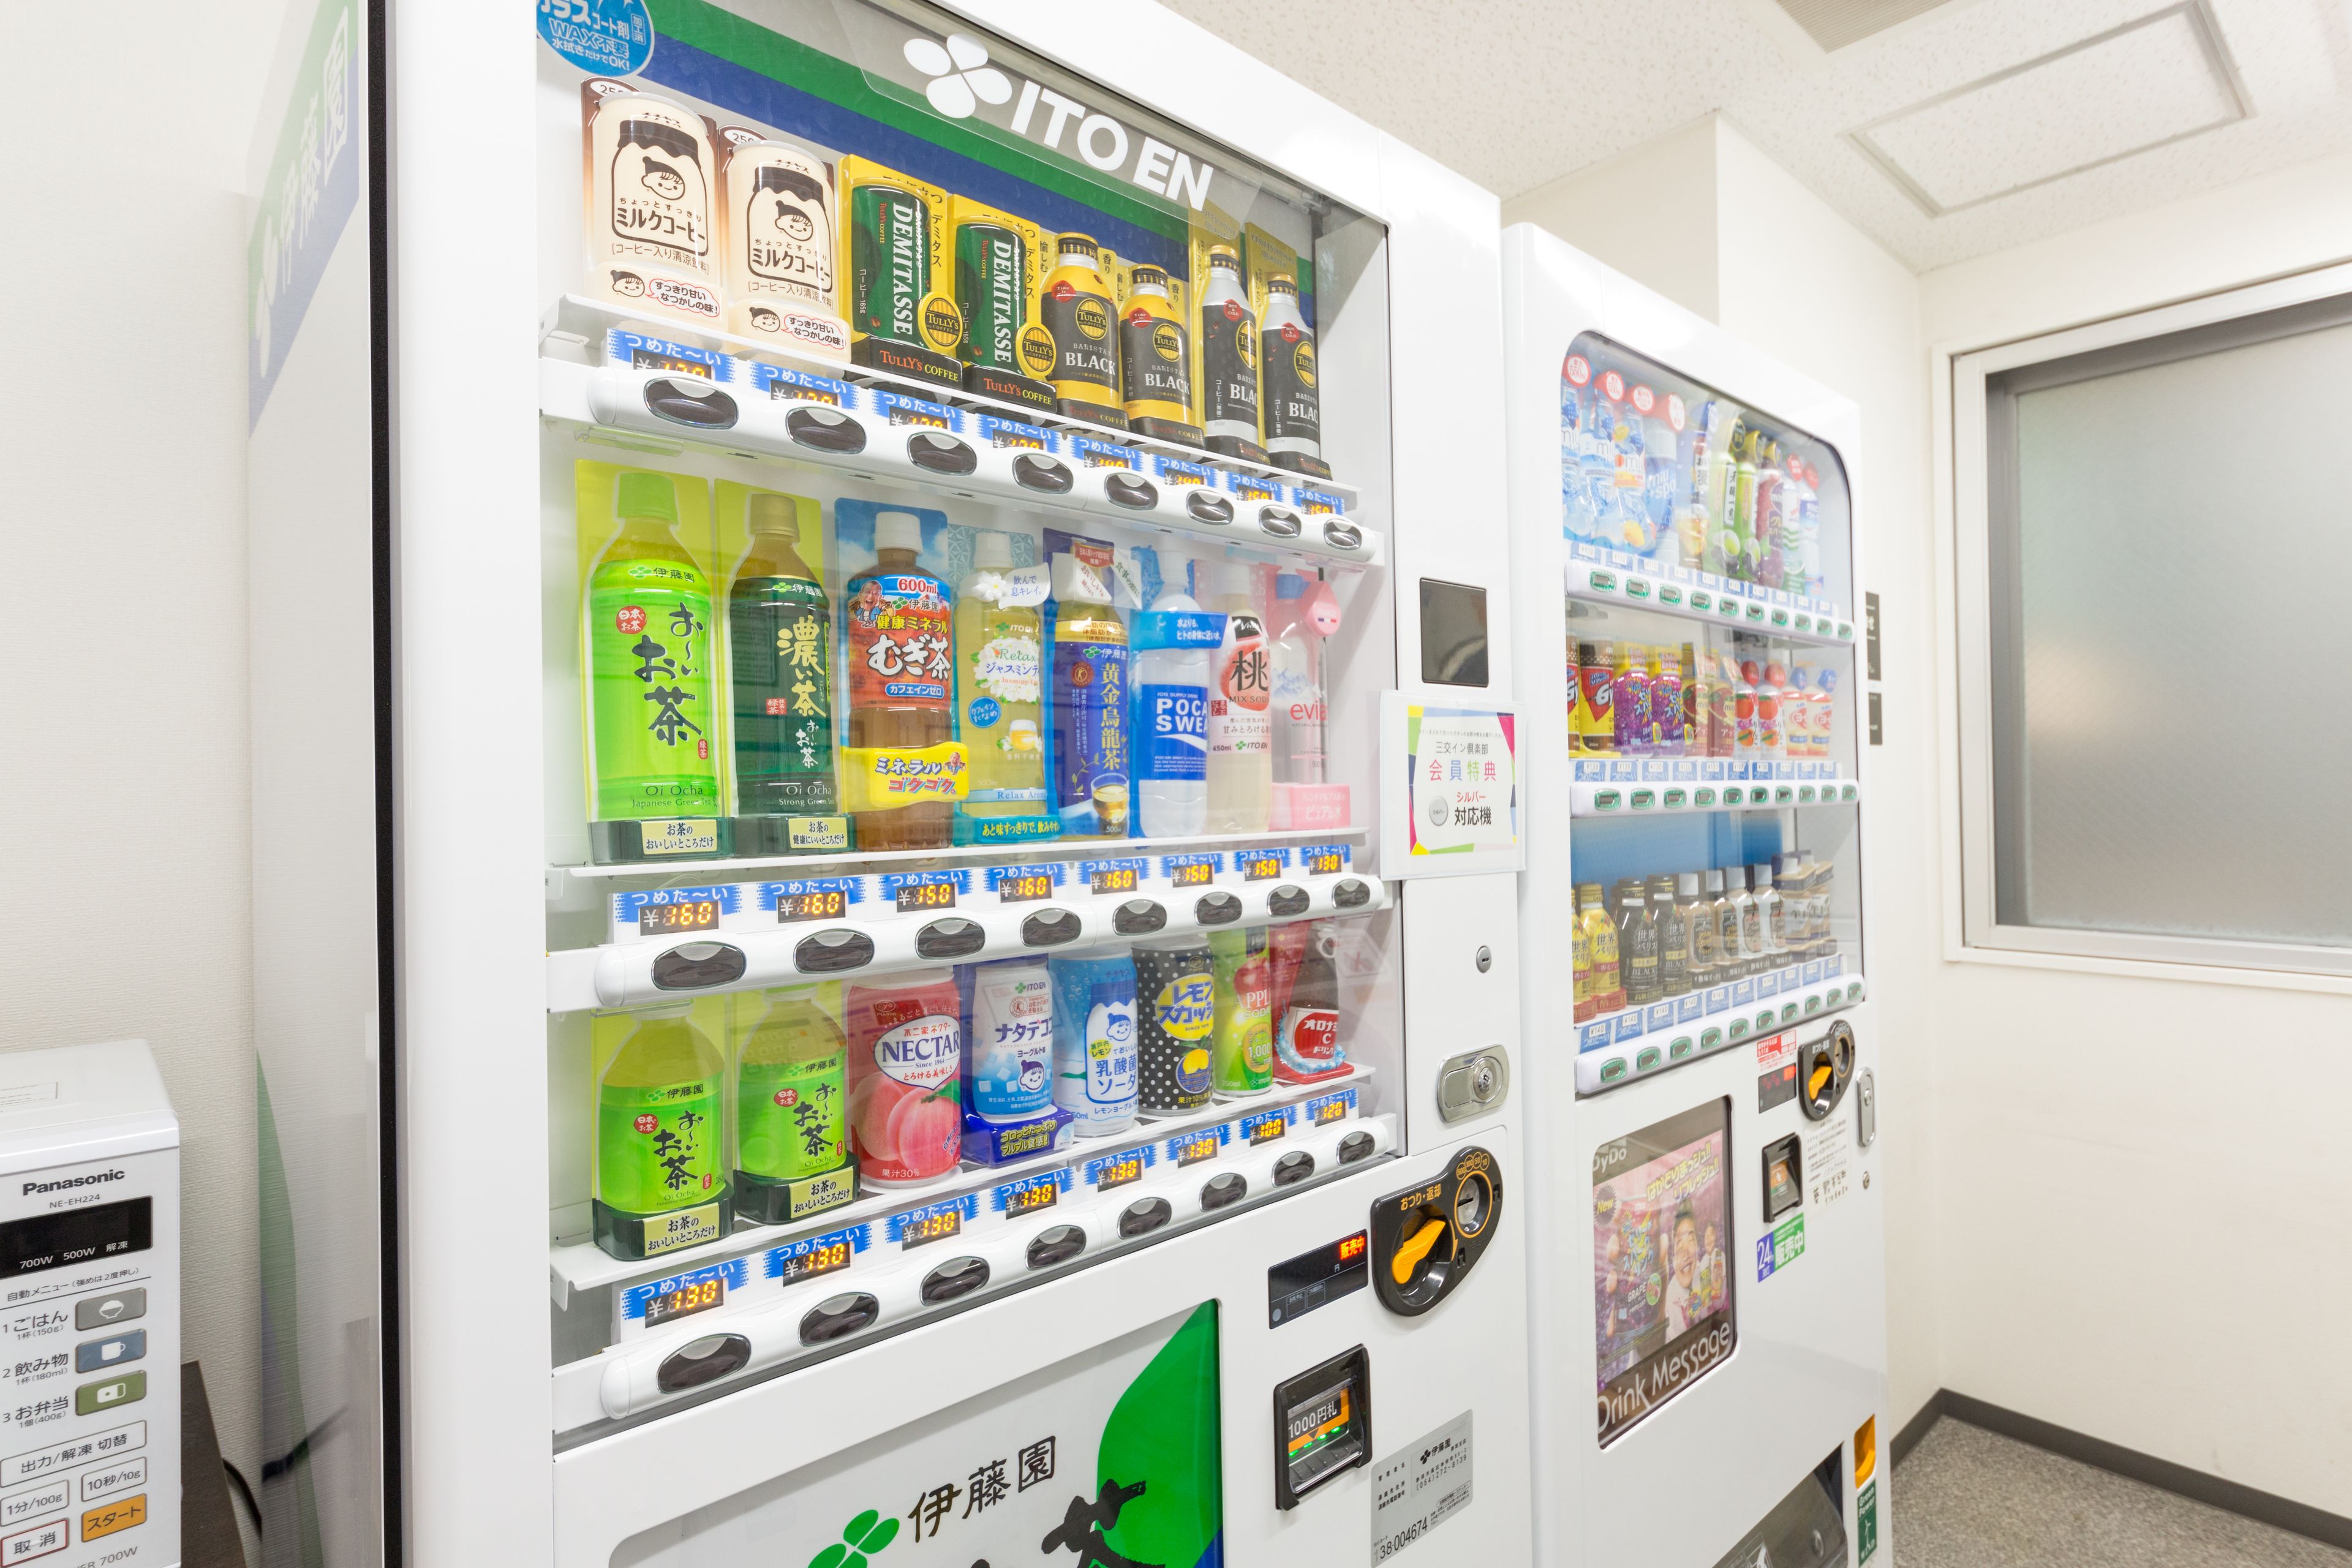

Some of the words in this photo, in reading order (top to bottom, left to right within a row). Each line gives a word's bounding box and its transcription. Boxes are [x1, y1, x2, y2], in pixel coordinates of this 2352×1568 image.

[549, 18, 629, 59] WAX不要
[552, 38, 630, 71] 水拭きだけでOK!
[643, 111, 681, 128] チチヤス
[1011, 80, 1128, 171] ITO
[1133, 136, 1213, 211] EN
[619, 197, 701, 222] ちょっとすっきり
[617, 208, 705, 244] ミルクコーヒー
[755, 238, 827, 261] ちょっとすっきり
[932, 214, 941, 268] デミタス
[752, 247, 831, 282] ミルクコーヒー
[893, 202, 913, 336] DEMITASSE
[655, 281, 706, 301] すっきり甘い
[993, 239, 1012, 363] DEMITASSE
[661, 293, 718, 314] なつかしの味!
[789, 317, 834, 334] すっきり甘い
[927, 312, 959, 330] TULLY'S
[1079, 311, 1106, 326] TULLY'S
[794, 328, 845, 347] なつかしの味!
[932, 325, 954, 334] COFFEE
[1023, 340, 1053, 356] TULLY'S
[880, 350, 922, 371] TULLY'S
[925, 364, 959, 382] COFFEE
[1065, 352, 1117, 376] BLACK
[984, 378, 1021, 397] TULLY'S
[1022, 389, 1053, 405] COFFEE
[1145, 372, 1190, 394] BLACK
[653, 566, 695, 584] 伊藤園
[1013, 575, 1037, 586] 飲んで
[792, 583, 823, 598] 伊藤園
[898, 578, 937, 594] 600ml
[909, 598, 940, 612] 伊藤園
[876, 615, 948, 635] 健康ミネラル
[776, 614, 826, 718] 濃い茶
[867, 633, 952, 680] むぎ茶
[1229, 651, 1268, 692] 桃
[889, 685, 942, 696] カフェインゼロ
[1100, 662, 1121, 771] 黄金烏龍茶
[1156, 698, 1207, 716] POCA
[1289, 700, 1328, 721] evia
[698, 739, 708, 759] 緑茶
[1435, 741, 1489, 756] 三交イン倶楽部
[875, 756, 943, 776] ミネラル
[1428, 759, 1497, 782] 会員特典
[645, 785, 664, 796] Oi
[670, 785, 704, 796] Ocha
[786, 785, 802, 795] Oi
[807, 784, 832, 795] Ocha
[997, 791, 1025, 799] Relax
[1457, 791, 1487, 802] シルバー
[632, 799, 672, 809] Japanese
[778, 797, 805, 808] Strong
[1454, 807, 1492, 827] 対応機
[666, 823, 693, 837] お茶の
[809, 821, 829, 834] お茶の
[645, 835, 714, 851] おいしいところだけ
[793, 831, 845, 846] 健康にいいところだけ
[1234, 988, 1271, 1010] APPL
[903, 1023, 951, 1037] 不二家ネクター
[1303, 1019, 1339, 1032] オロナミ
[882, 1031, 960, 1063] NECTAR
[1322, 1032, 1332, 1044] C
[1091, 1048, 1112, 1058] レモン
[805, 1058, 838, 1073] 伊藤園
[903, 1066, 953, 1081] とろける美味しさ
[1095, 1058, 1137, 1078] 乳酸菌
[667, 1084, 704, 1099] 伊藤園
[22, 1168, 126, 1197] Panasonic
[881, 1168, 920, 1178] 果汁30%
[676, 1191, 695, 1200] Ocha
[811, 1182, 837, 1196] お茶の
[1400, 1183, 1442, 1212] おつり・返却
[49, 1194, 101, 1210] NE-EH224
[793, 1189, 851, 1213] おいしいところだけ
[1596, 1198, 1614, 1215] New
[668, 1218, 699, 1232] お茶の
[647, 1225, 716, 1251] おいしいところだけ
[1339, 1235, 1366, 1261] 販売中
[19, 1254, 54, 1270] 700W
[62, 1246, 97, 1261] 500W
[105, 1240, 129, 1253] 解凍
[1334, 1264, 1340, 1273] 円
[7, 1281, 70, 1302] 自動メニュー
[2, 1324, 9, 1334] 1
[13, 1311, 69, 1335] ごはん
[2, 1368, 10, 1378] 2
[14, 1352, 69, 1377] 飲み物
[1651, 1321, 1730, 1398] Message
[2, 1412, 10, 1423] 3
[15, 1395, 69, 1421] お弁当
[1288, 1401, 1338, 1439] 1000円札
[21, 1442, 93, 1474] 出力/解凍
[98, 1432, 129, 1449] 切替
[1431, 1438, 1451, 1457] 伊藤園
[87, 1467, 141, 1492] 10秒/10g
[907, 1435, 1057, 1544] 伊藤園
[6, 1492, 64, 1516] 1分/100g
[1858, 1487, 1875, 1507] Green
[1858, 1496, 1875, 1517] Power
[87, 1505, 141, 1531] スタート
[13, 1531, 57, 1556] 取消
[100, 1545, 139, 1566] 700W
